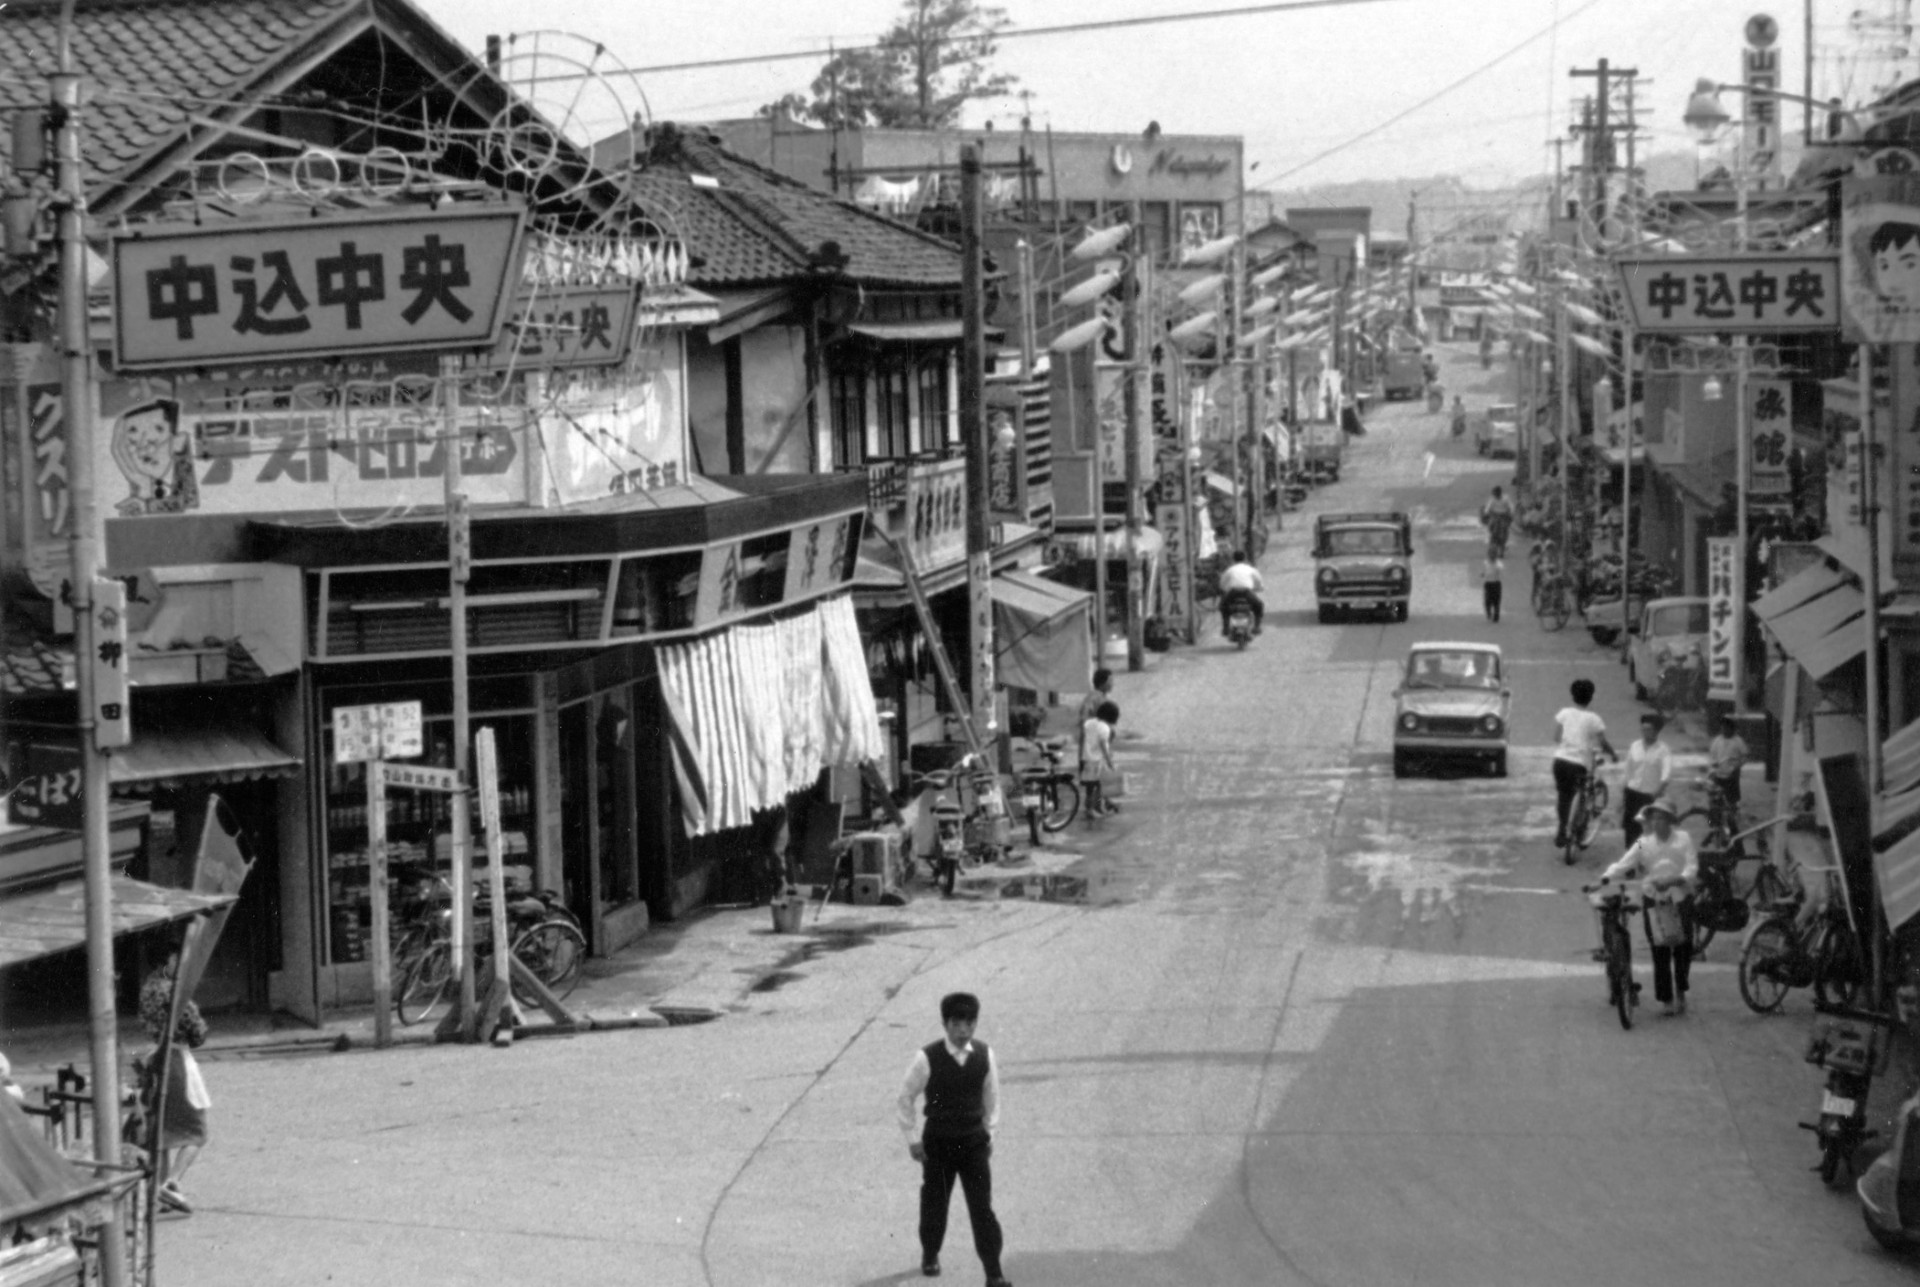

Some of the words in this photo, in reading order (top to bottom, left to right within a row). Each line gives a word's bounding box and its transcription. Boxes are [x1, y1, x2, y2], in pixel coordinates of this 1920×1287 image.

[146, 233, 473, 340] 中込中央
[504, 301, 613, 354] 込中央
[1648, 267, 1825, 319] 中込中央
[33, 390, 68, 535] クスリ
[1164, 525, 1184, 615] アサヒビール
[1711, 574, 1733, 679] パチンコ
